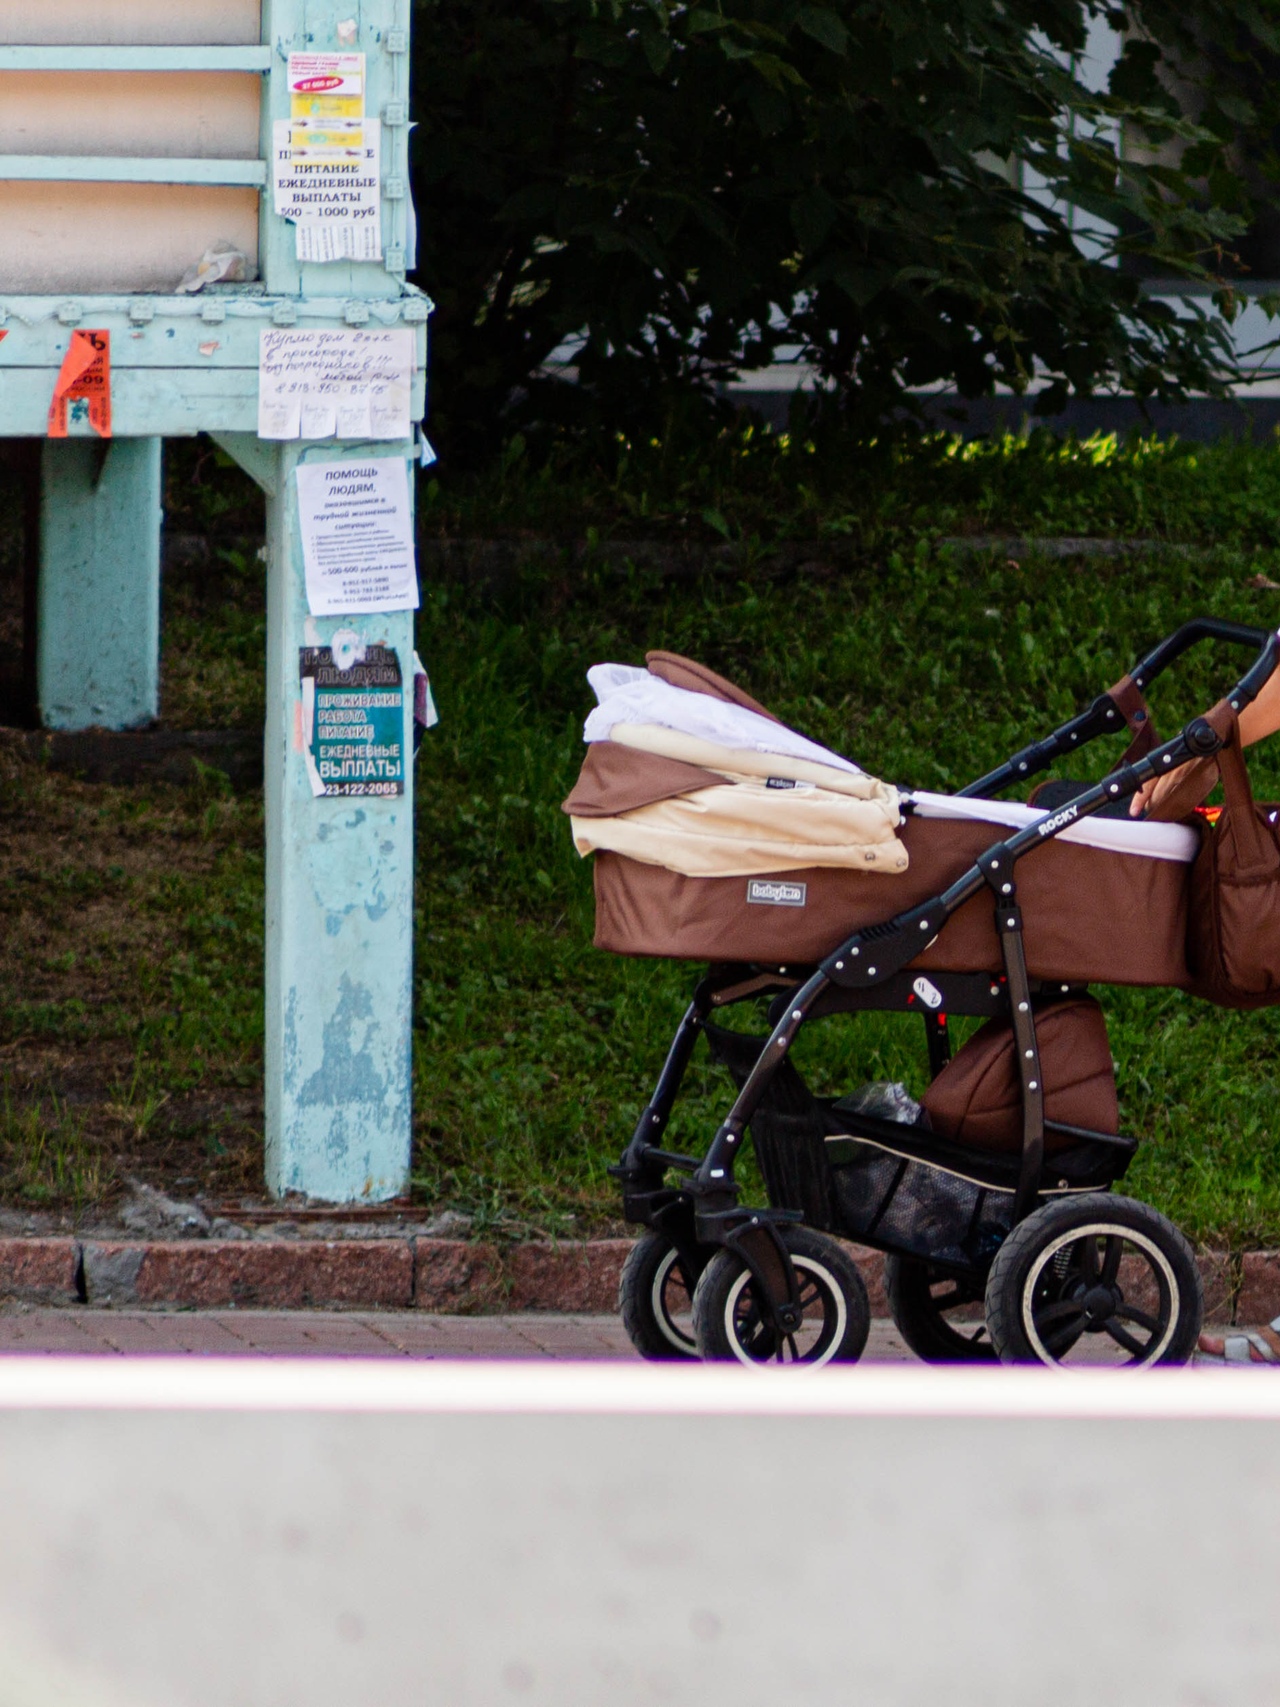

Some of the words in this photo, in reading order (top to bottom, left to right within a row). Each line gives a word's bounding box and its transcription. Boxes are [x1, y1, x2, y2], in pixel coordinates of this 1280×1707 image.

[294, 164, 360, 174] ПИТАНИЕ
[278, 178, 376, 189] ЕЖЕДНЕВНЫЕ
[292, 192, 361, 203] ВЫПЛАТЫ
[318, 207, 348, 217] 1000
[353, 206, 376, 219] руб
[317, 333, 345, 348] дом
[325, 467, 378, 480] ПОМОЩЬ
[328, 483, 377, 496] ЛЮДЯМ,
[313, 510, 350, 521] трудной
[351, 506, 397, 517] жизненной
[317, 666, 398, 686] ЛЮДЯМ
[318, 693, 401, 708] ПРОЖИВАНИЕ
[318, 709, 367, 723] РАБОТА
[318, 724, 375, 739] ПИТАНИЕ
[319, 745, 400, 759] ЕЖЕДНЕВНЫЕ
[319, 760, 401, 778] ВЫПЛАТЫ
[1038, 804, 1078, 836] ROCKY
